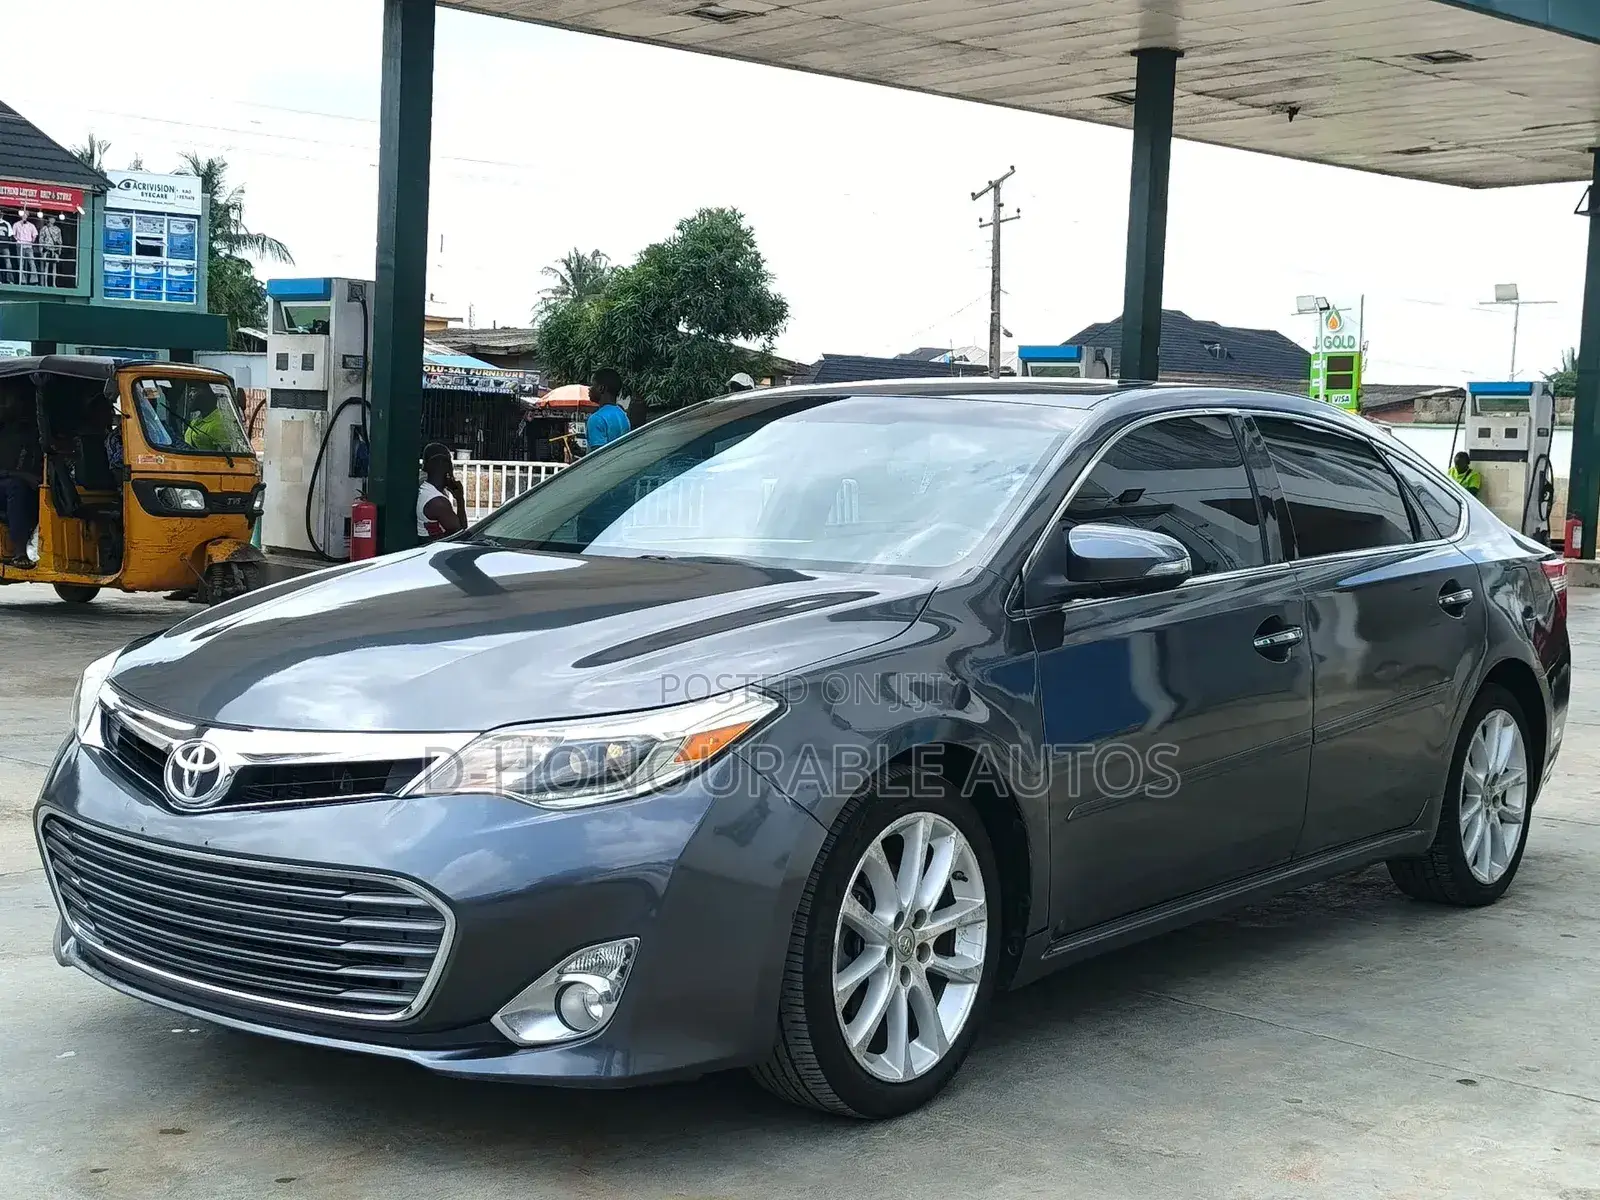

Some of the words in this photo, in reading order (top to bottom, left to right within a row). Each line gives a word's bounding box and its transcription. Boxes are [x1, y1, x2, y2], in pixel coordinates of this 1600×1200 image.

[132, 182, 175, 193] ACRIVISION
[141, 191, 168, 200] EYECARE
[1323, 335, 1356, 350] GOLD
[423, 365, 467, 375] OLU-SAL
[470, 369, 525, 379] FURNITURE
[1334, 395, 1350, 403] VISA
